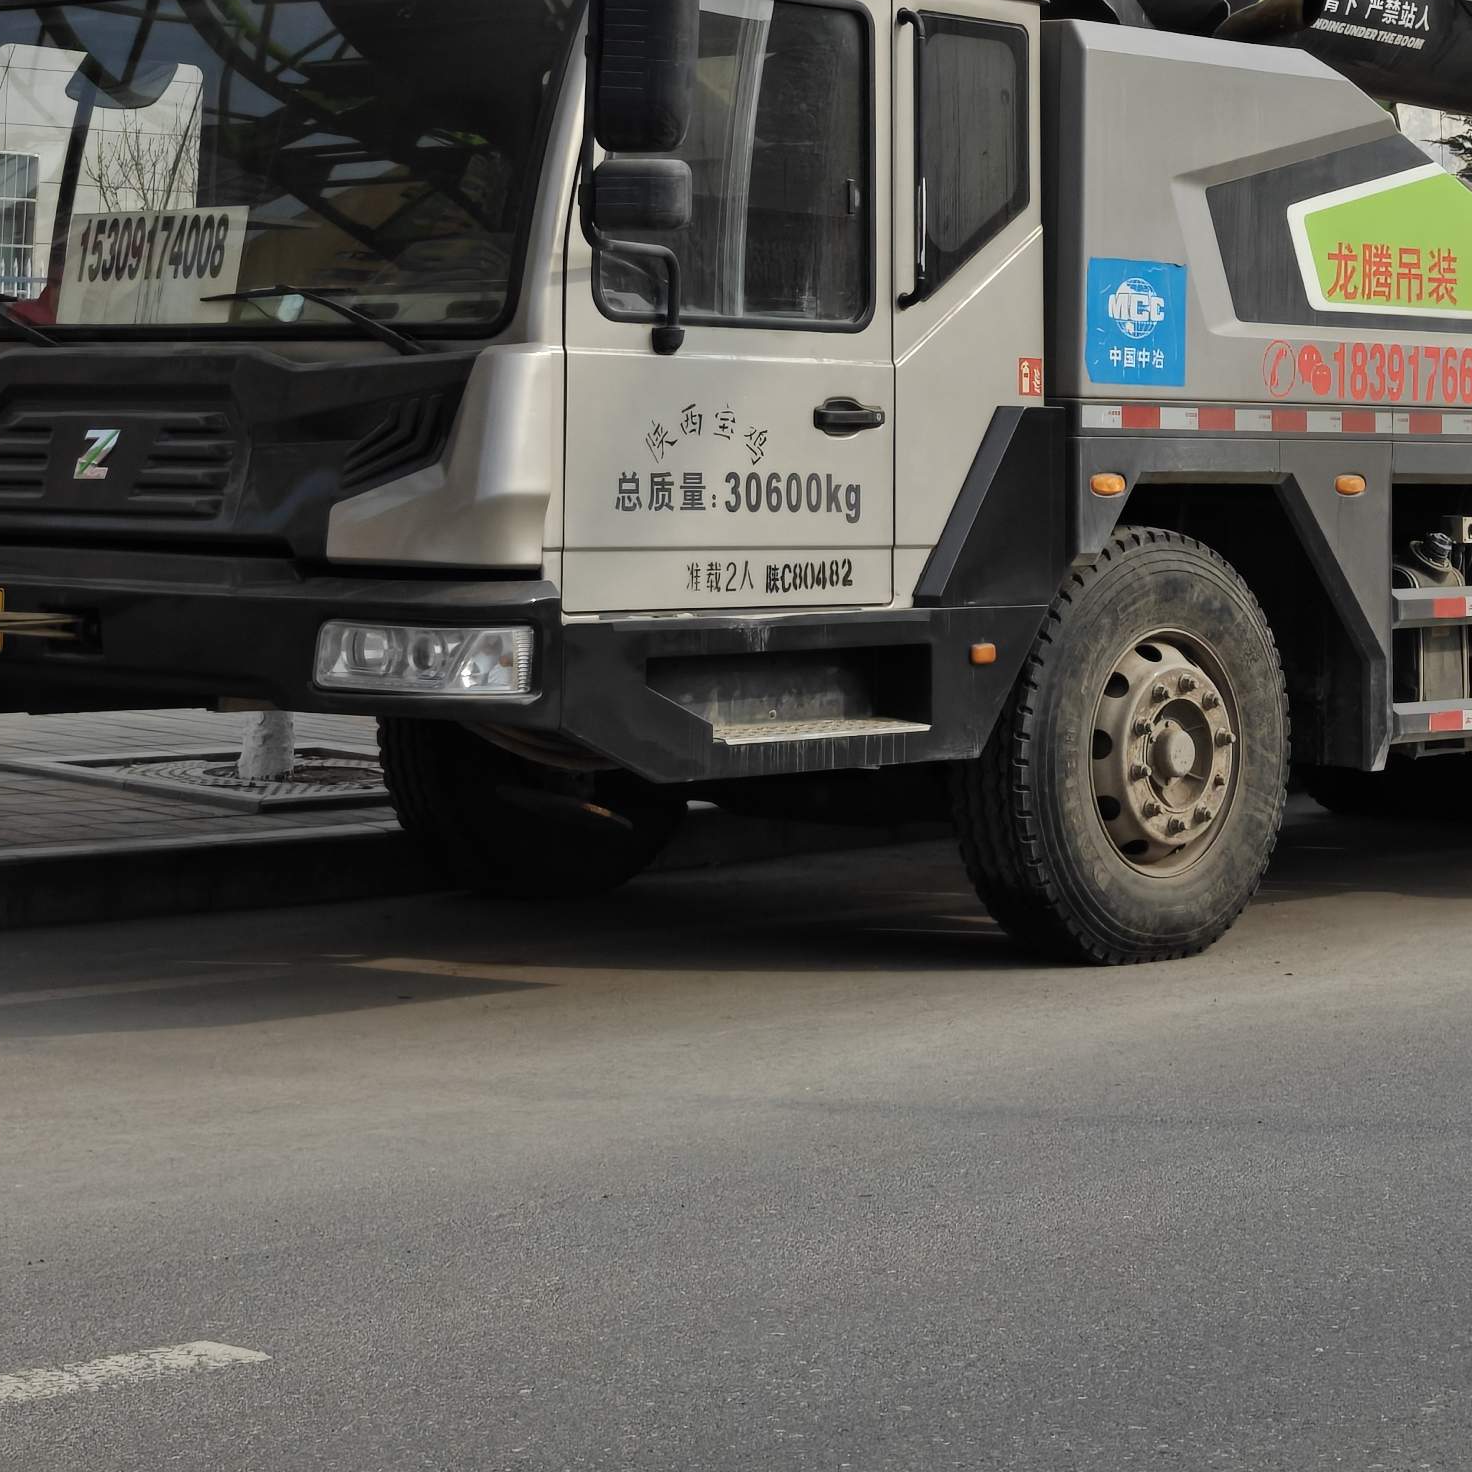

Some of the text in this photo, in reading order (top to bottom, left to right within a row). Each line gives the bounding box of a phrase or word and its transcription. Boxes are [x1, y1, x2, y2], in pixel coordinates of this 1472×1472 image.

[77, 213, 230, 283] 15309174008
[1327, 241, 1458, 306] 龙腾吊装
[1108, 293, 1165, 322] MCC
[1109, 345, 1165, 369] 中国中冶
